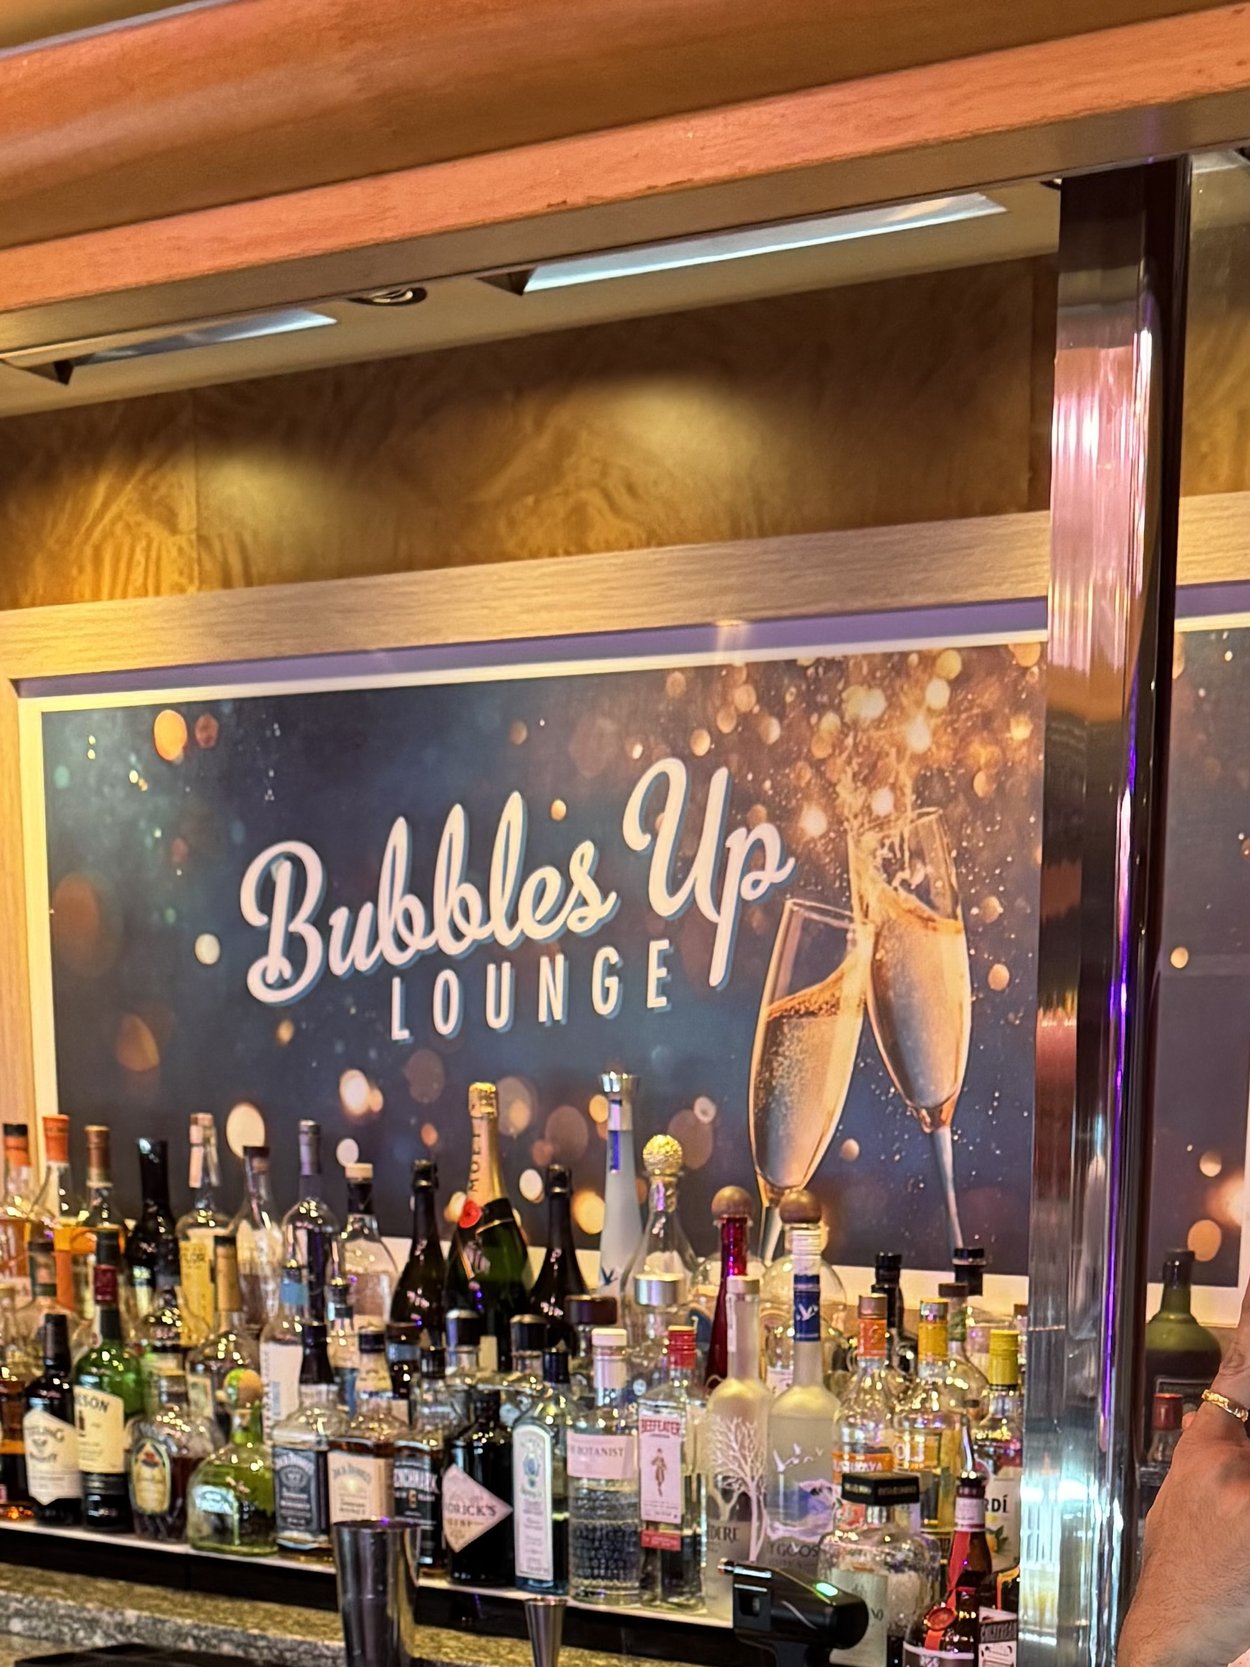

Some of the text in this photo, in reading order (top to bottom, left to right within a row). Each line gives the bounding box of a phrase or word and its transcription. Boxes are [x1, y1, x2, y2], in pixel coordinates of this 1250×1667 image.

[240, 757, 797, 1005] Bubbles Up
[390, 938, 672, 1043] LOUNGE
